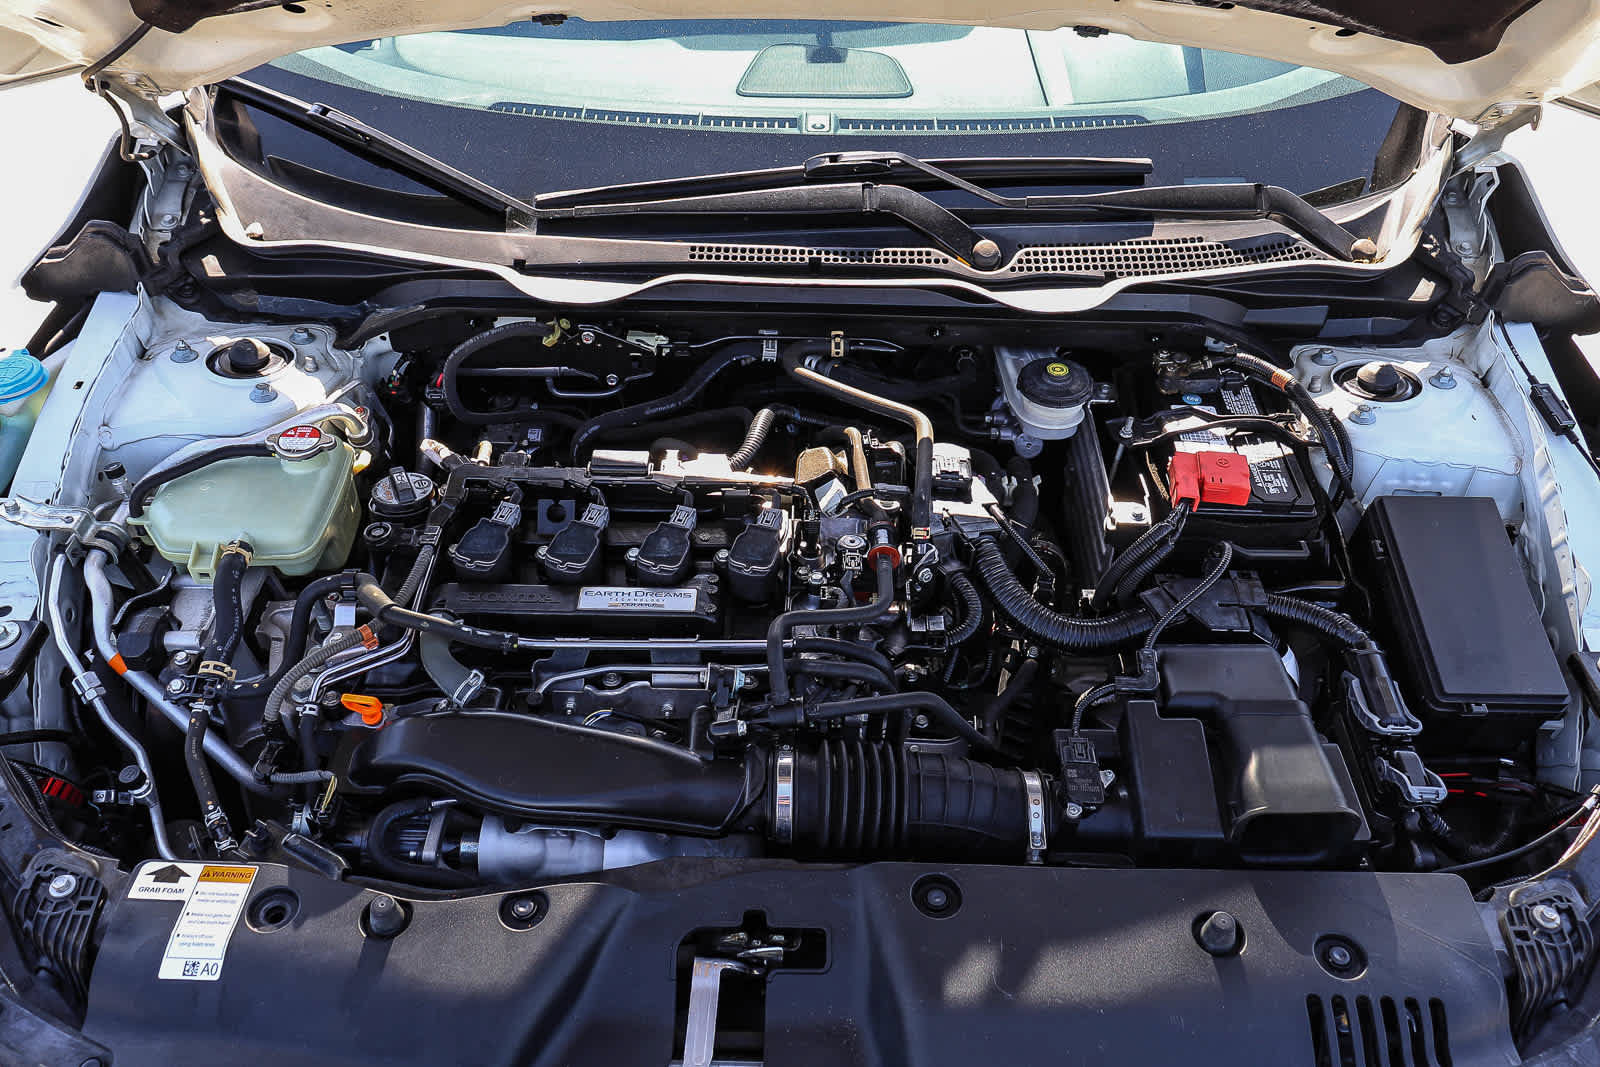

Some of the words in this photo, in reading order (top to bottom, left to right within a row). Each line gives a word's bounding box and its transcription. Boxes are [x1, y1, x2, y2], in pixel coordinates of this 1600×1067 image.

[584, 590, 631, 598] EARTH
[634, 590, 693, 599] DREAMS
[211, 871, 252, 879] WARNING
[138, 886, 161, 894] GRAB
[162, 887, 185, 895] FOAM
